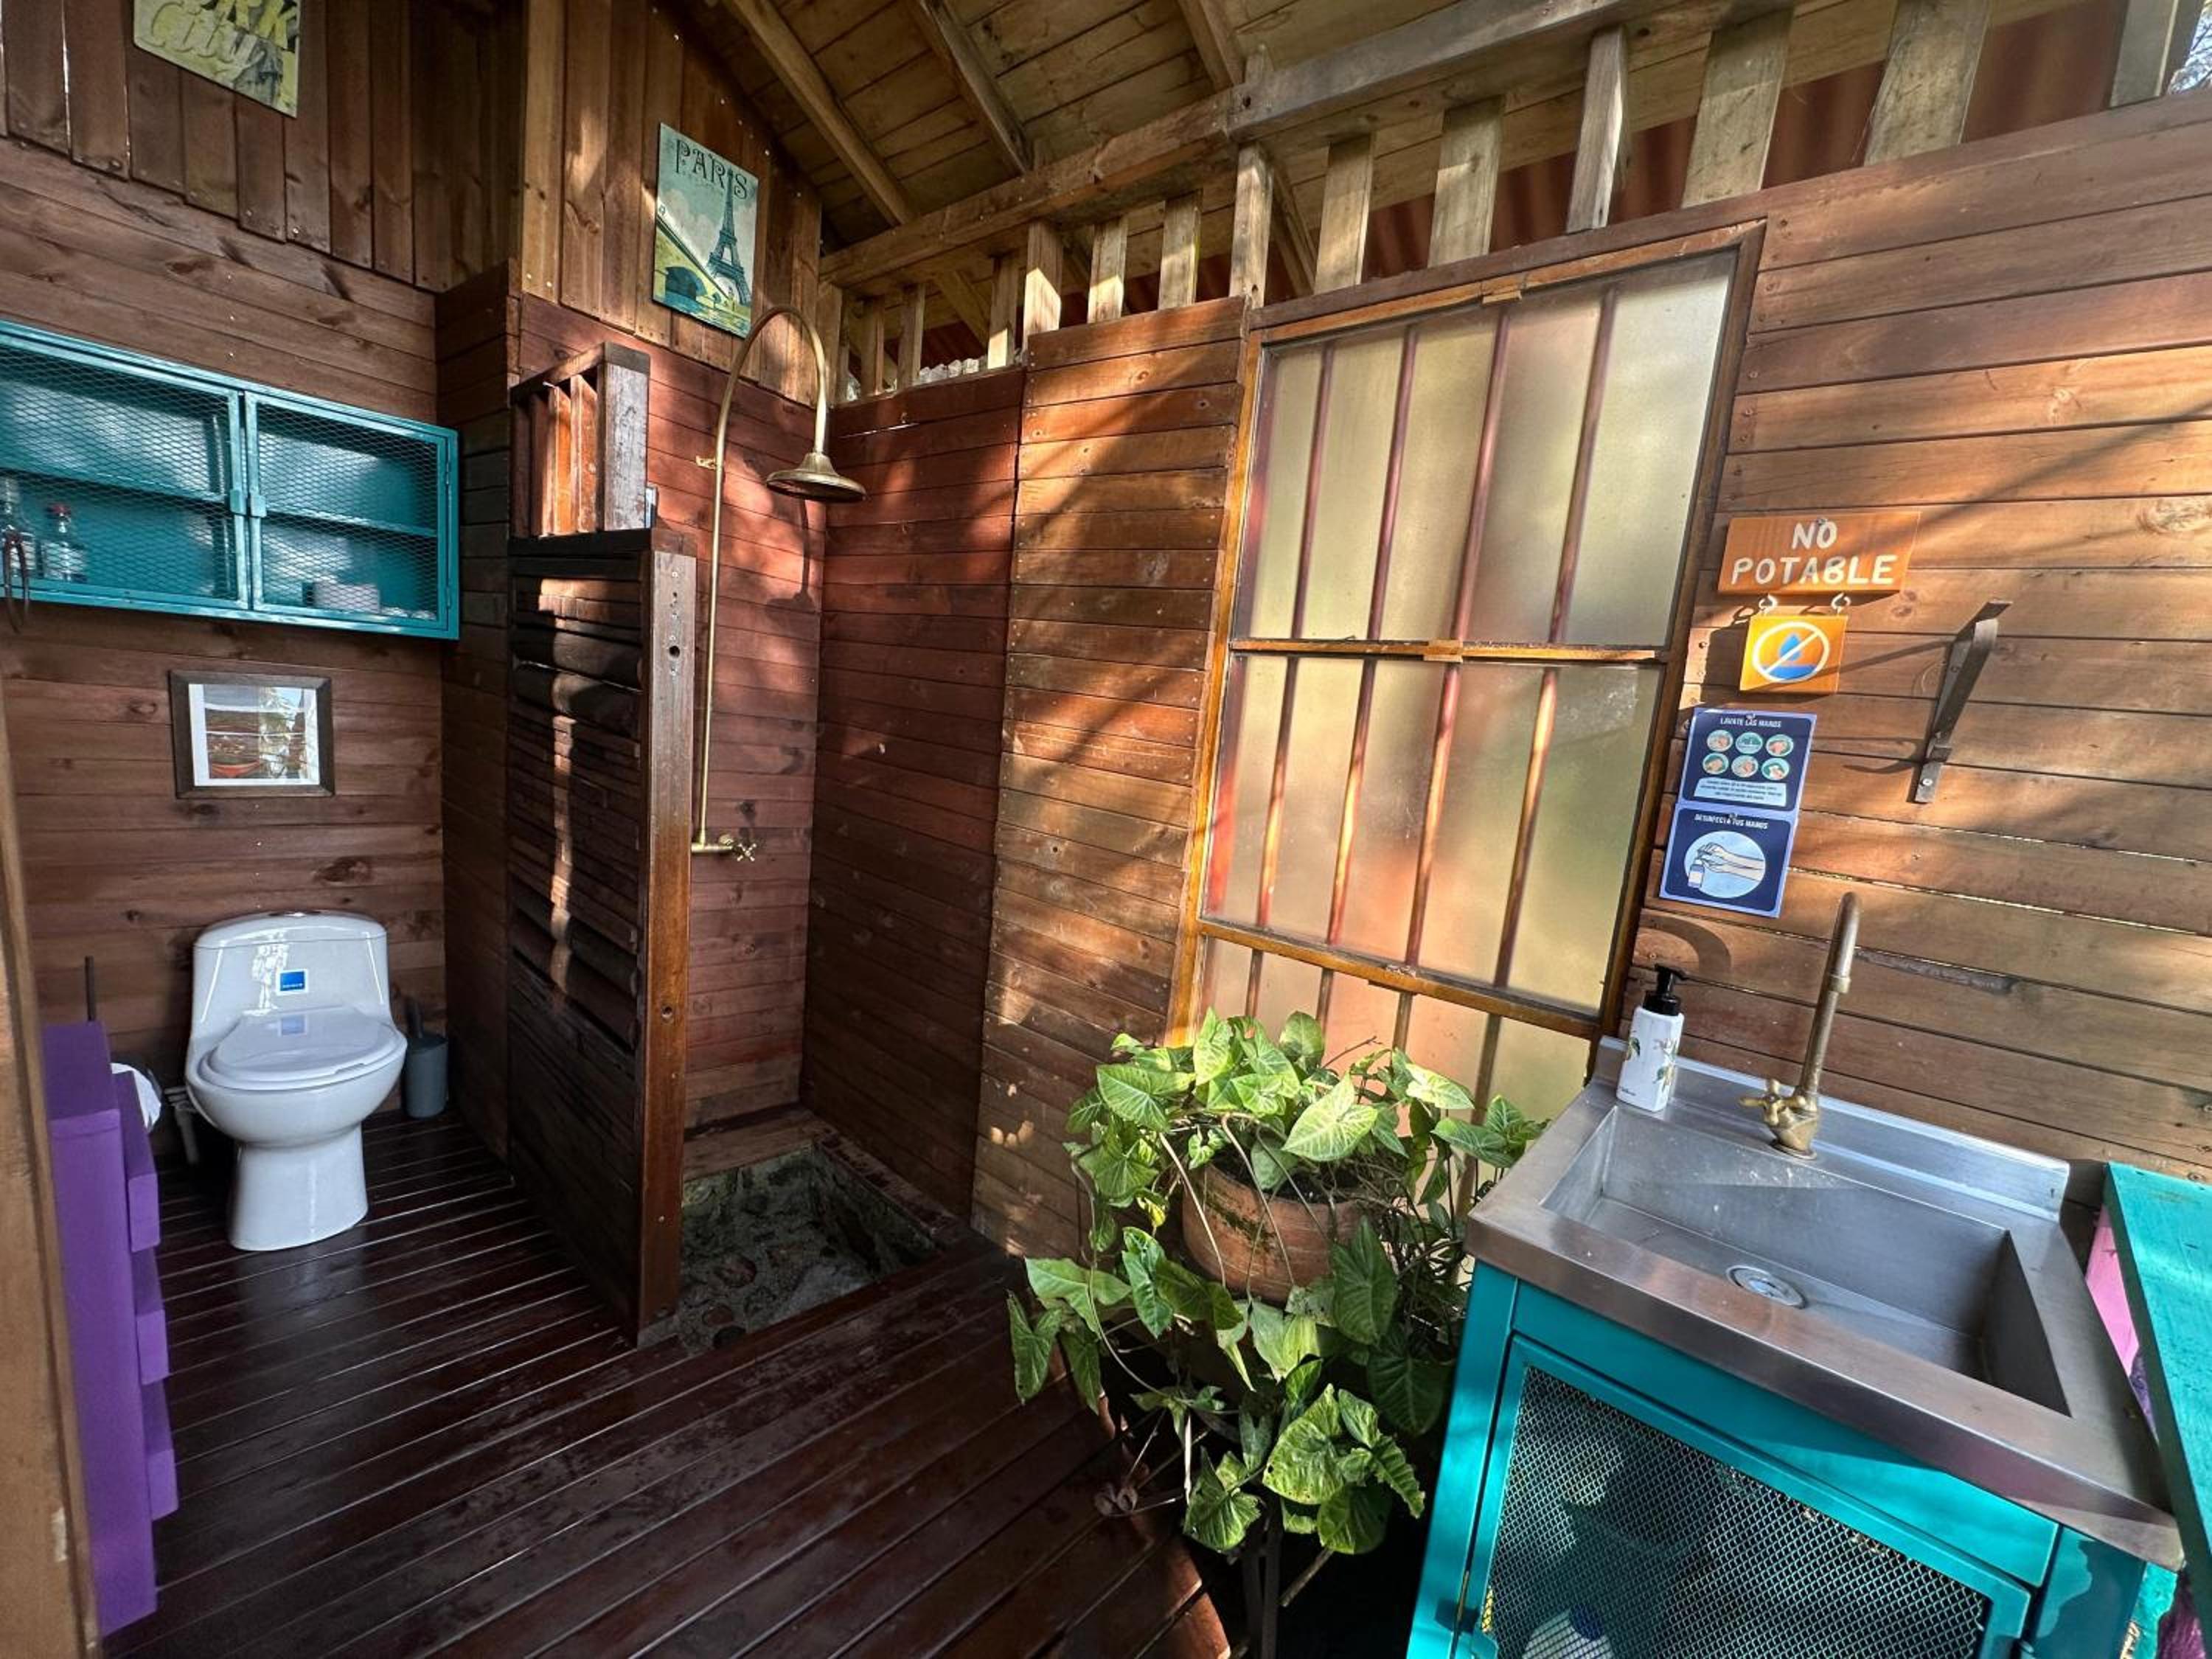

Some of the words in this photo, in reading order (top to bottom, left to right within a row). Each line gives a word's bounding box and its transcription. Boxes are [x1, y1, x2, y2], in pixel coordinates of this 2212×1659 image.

[675, 139, 748, 200] PARIS
[1791, 518, 1837, 549] NO
[1731, 554, 1898, 585] POTABLE
